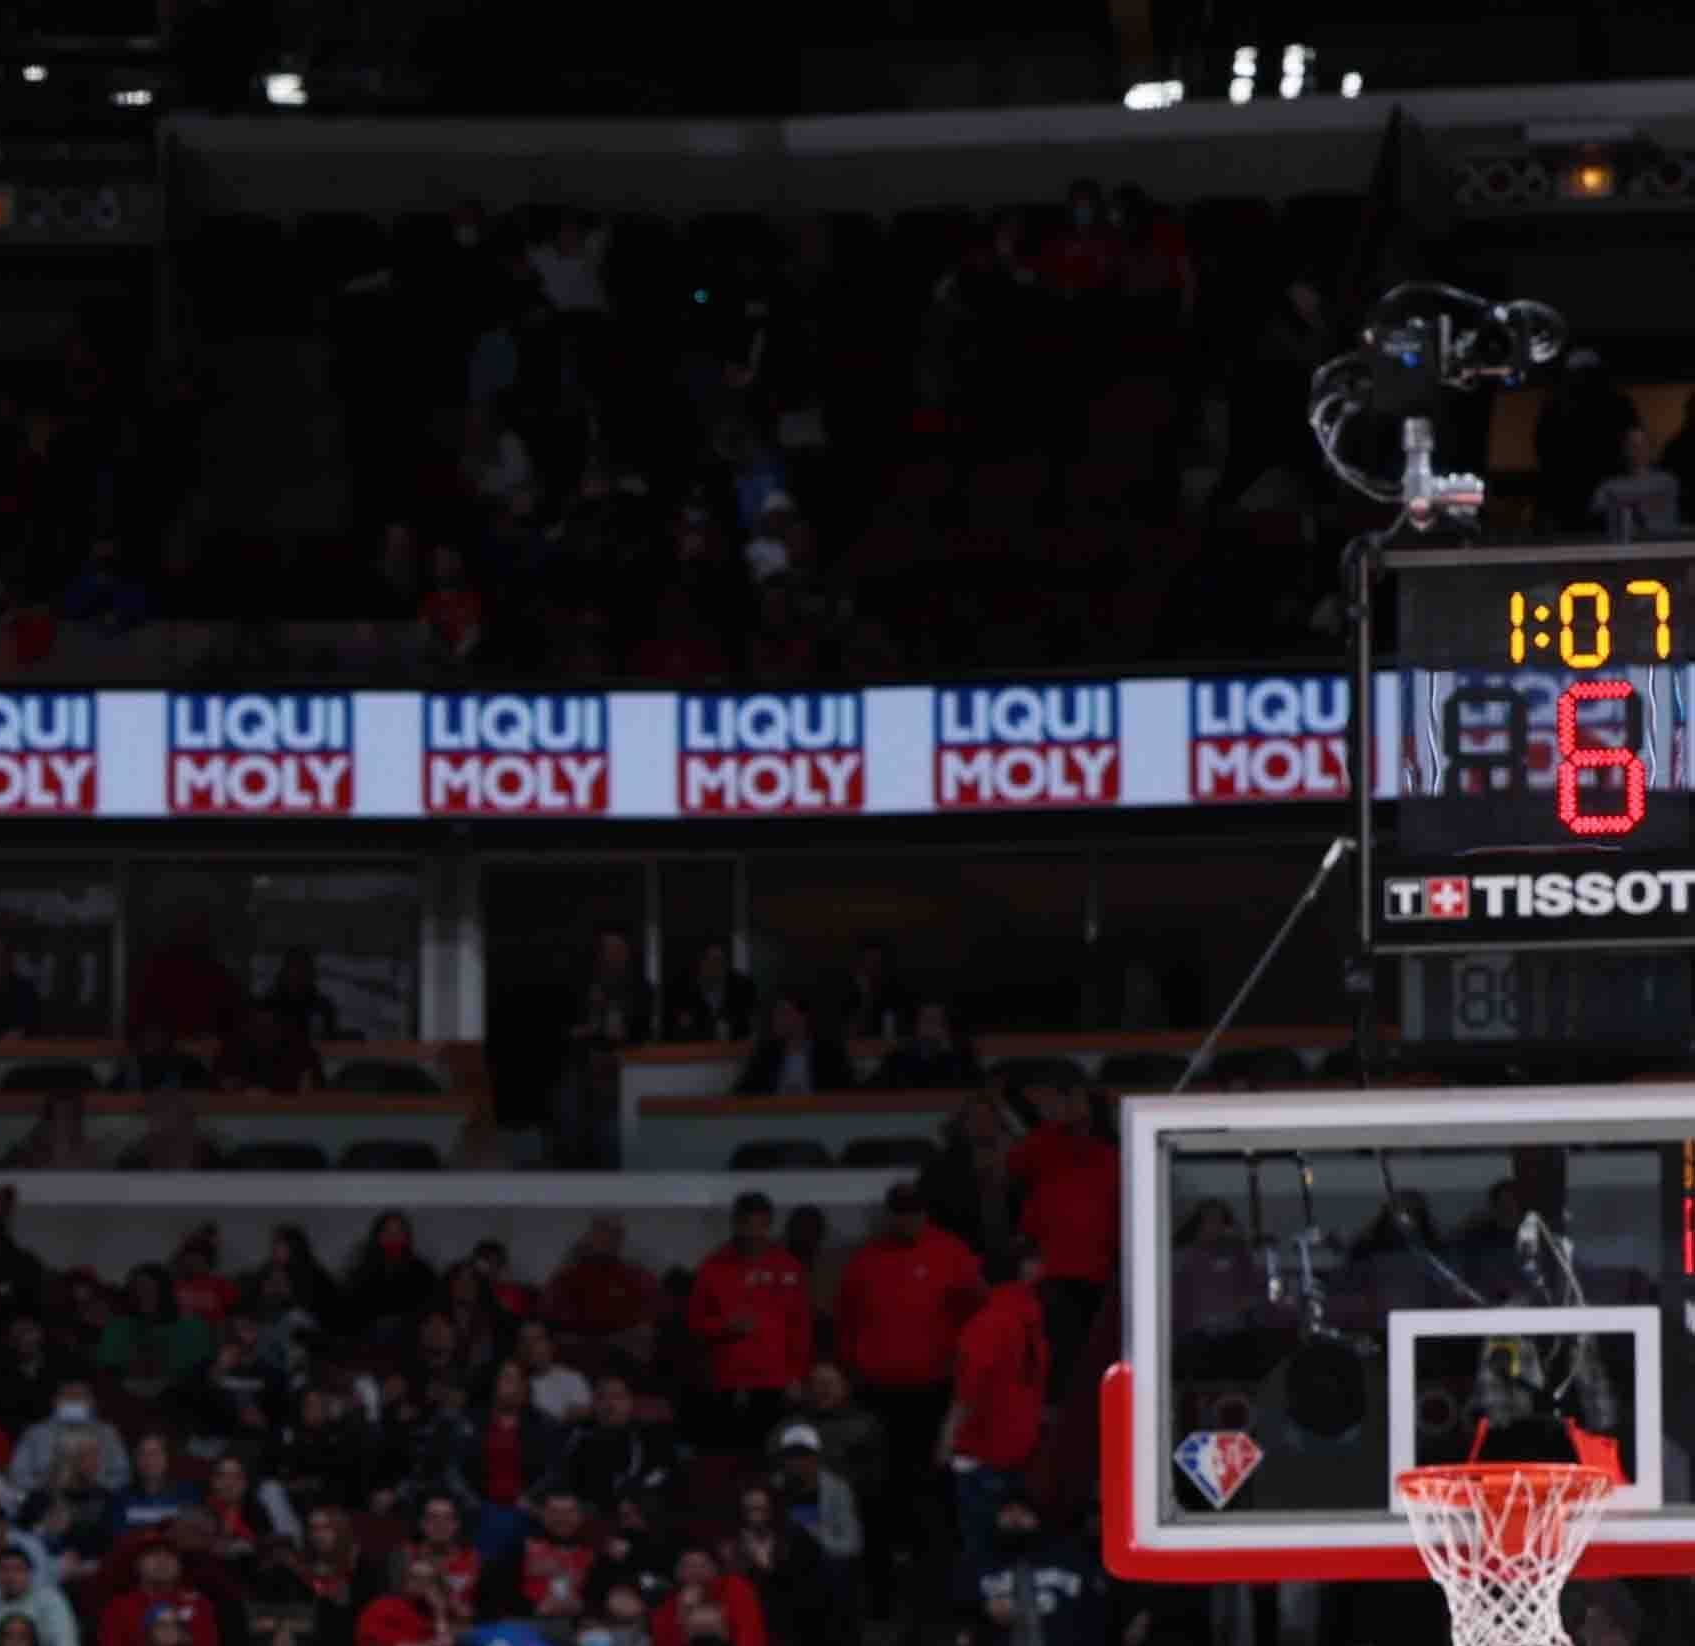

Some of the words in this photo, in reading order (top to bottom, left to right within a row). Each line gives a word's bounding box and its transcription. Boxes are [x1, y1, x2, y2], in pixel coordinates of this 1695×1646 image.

[1510, 581, 1671, 668] 1:07
[175, 695, 345, 751] LIQUI
[431, 695, 600, 751] LIQUI
[686, 696, 856, 752] LIQUI
[942, 687, 1111, 744] LIQUI
[1196, 680, 1350, 736] LIQU
[173, 754, 351, 810] MOLY
[429, 754, 606, 810] MOLY
[684, 752, 861, 809] MOLY
[940, 744, 1118, 802] MOLY
[1557, 681, 1645, 834] 6
[1472, 870, 1695, 918] TISSOT
